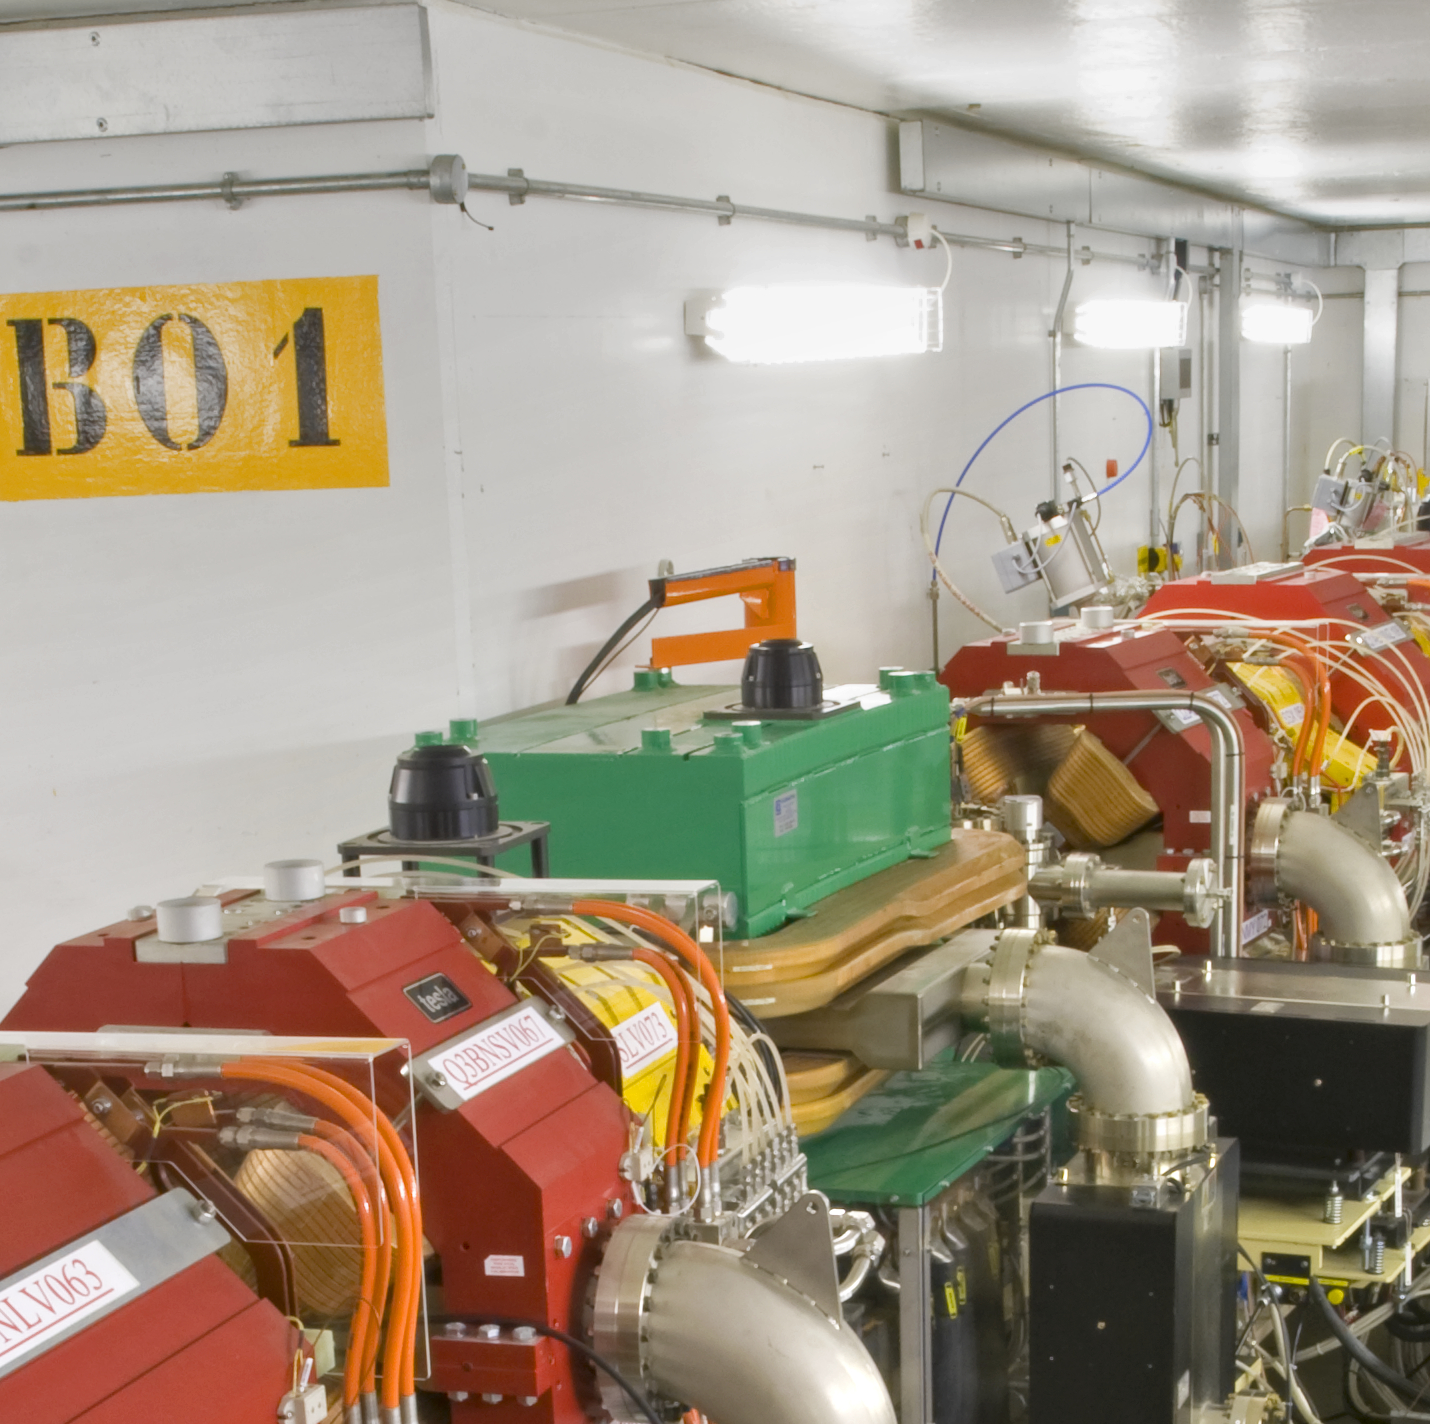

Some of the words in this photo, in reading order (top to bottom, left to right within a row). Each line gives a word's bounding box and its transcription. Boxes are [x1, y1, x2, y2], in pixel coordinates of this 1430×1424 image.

[6, 306, 342, 457] B01
[417, 985, 459, 1013] tesla
[442, 1014, 547, 1086] Q3BNSV067
